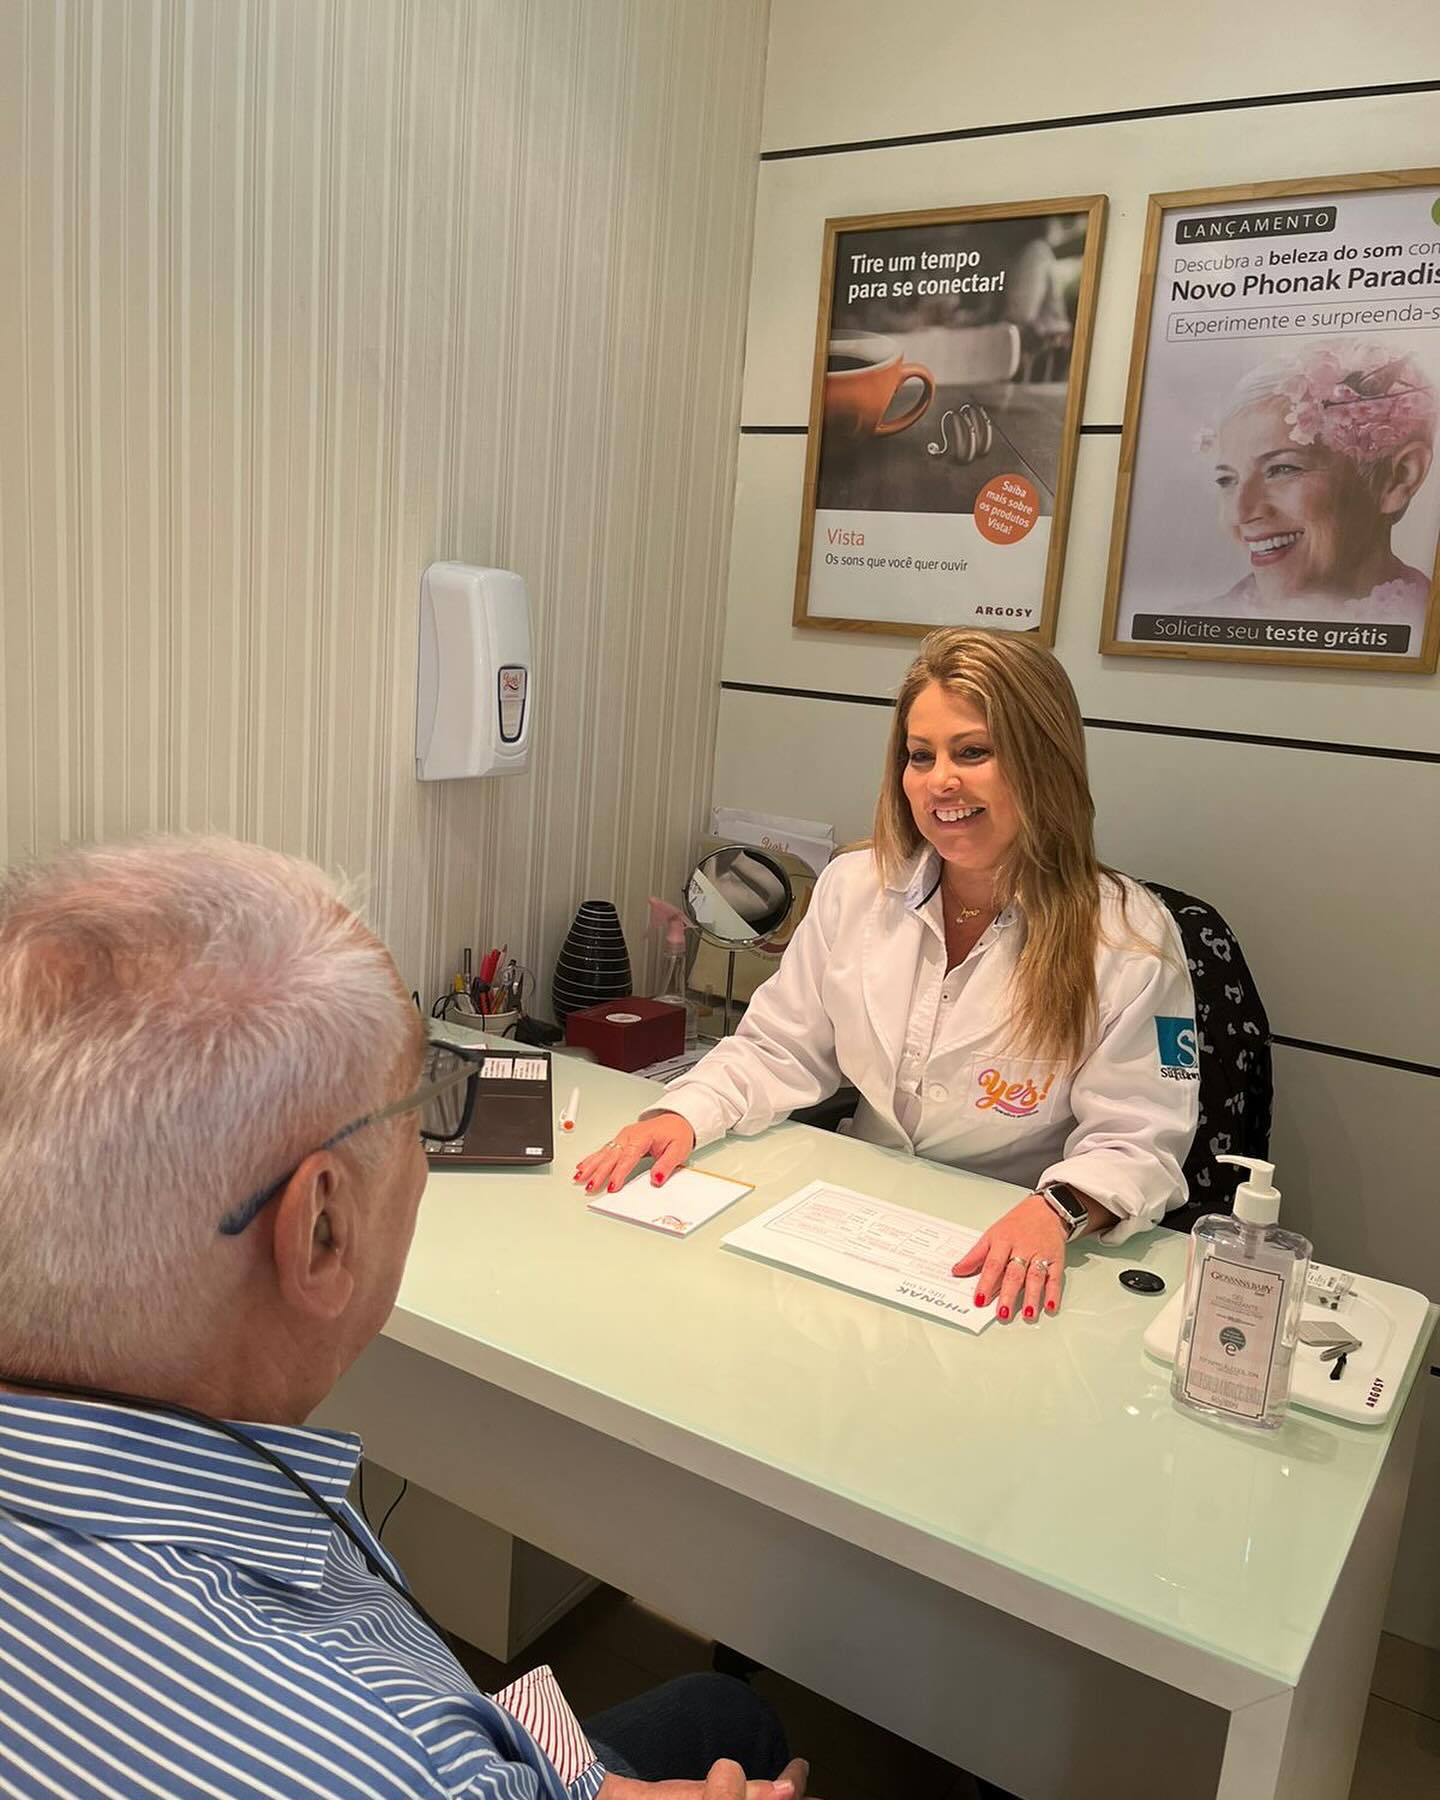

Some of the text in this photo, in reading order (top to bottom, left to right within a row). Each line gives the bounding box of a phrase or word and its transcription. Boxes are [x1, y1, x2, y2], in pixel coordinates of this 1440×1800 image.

[1183, 212, 1329, 238] LANÇAMENTO
[851, 251, 980, 274] Tire um tempo
[1174, 254, 1250, 274] Descubra
[1254, 255, 1264, 267] a
[1269, 249, 1328, 266] beleza
[1333, 245, 1357, 261] do
[1363, 245, 1403, 259] som
[848, 271, 1005, 304] para se conectar!
[1171, 280, 1236, 301] Novo
[1242, 268, 1342, 297] Phonak
[1175, 313, 1290, 337] Experimente
[1294, 315, 1306, 327] e
[1002, 481, 1027, 498] Saiba
[979, 502, 1030, 528] os produtos
[986, 490, 1033, 515] mais sobre
[827, 528, 865, 546] Vista
[988, 517, 1013, 535] Vista!
[825, 553, 968, 571] Os sons que você quer ouvir
[975, 605, 1033, 618] ARGOSY
[1154, 618, 1389, 648] Solicite seu teste grátis
[896, 1285, 970, 1314] PHONAK
[1365, 1377, 1384, 1408] ARGOSY
